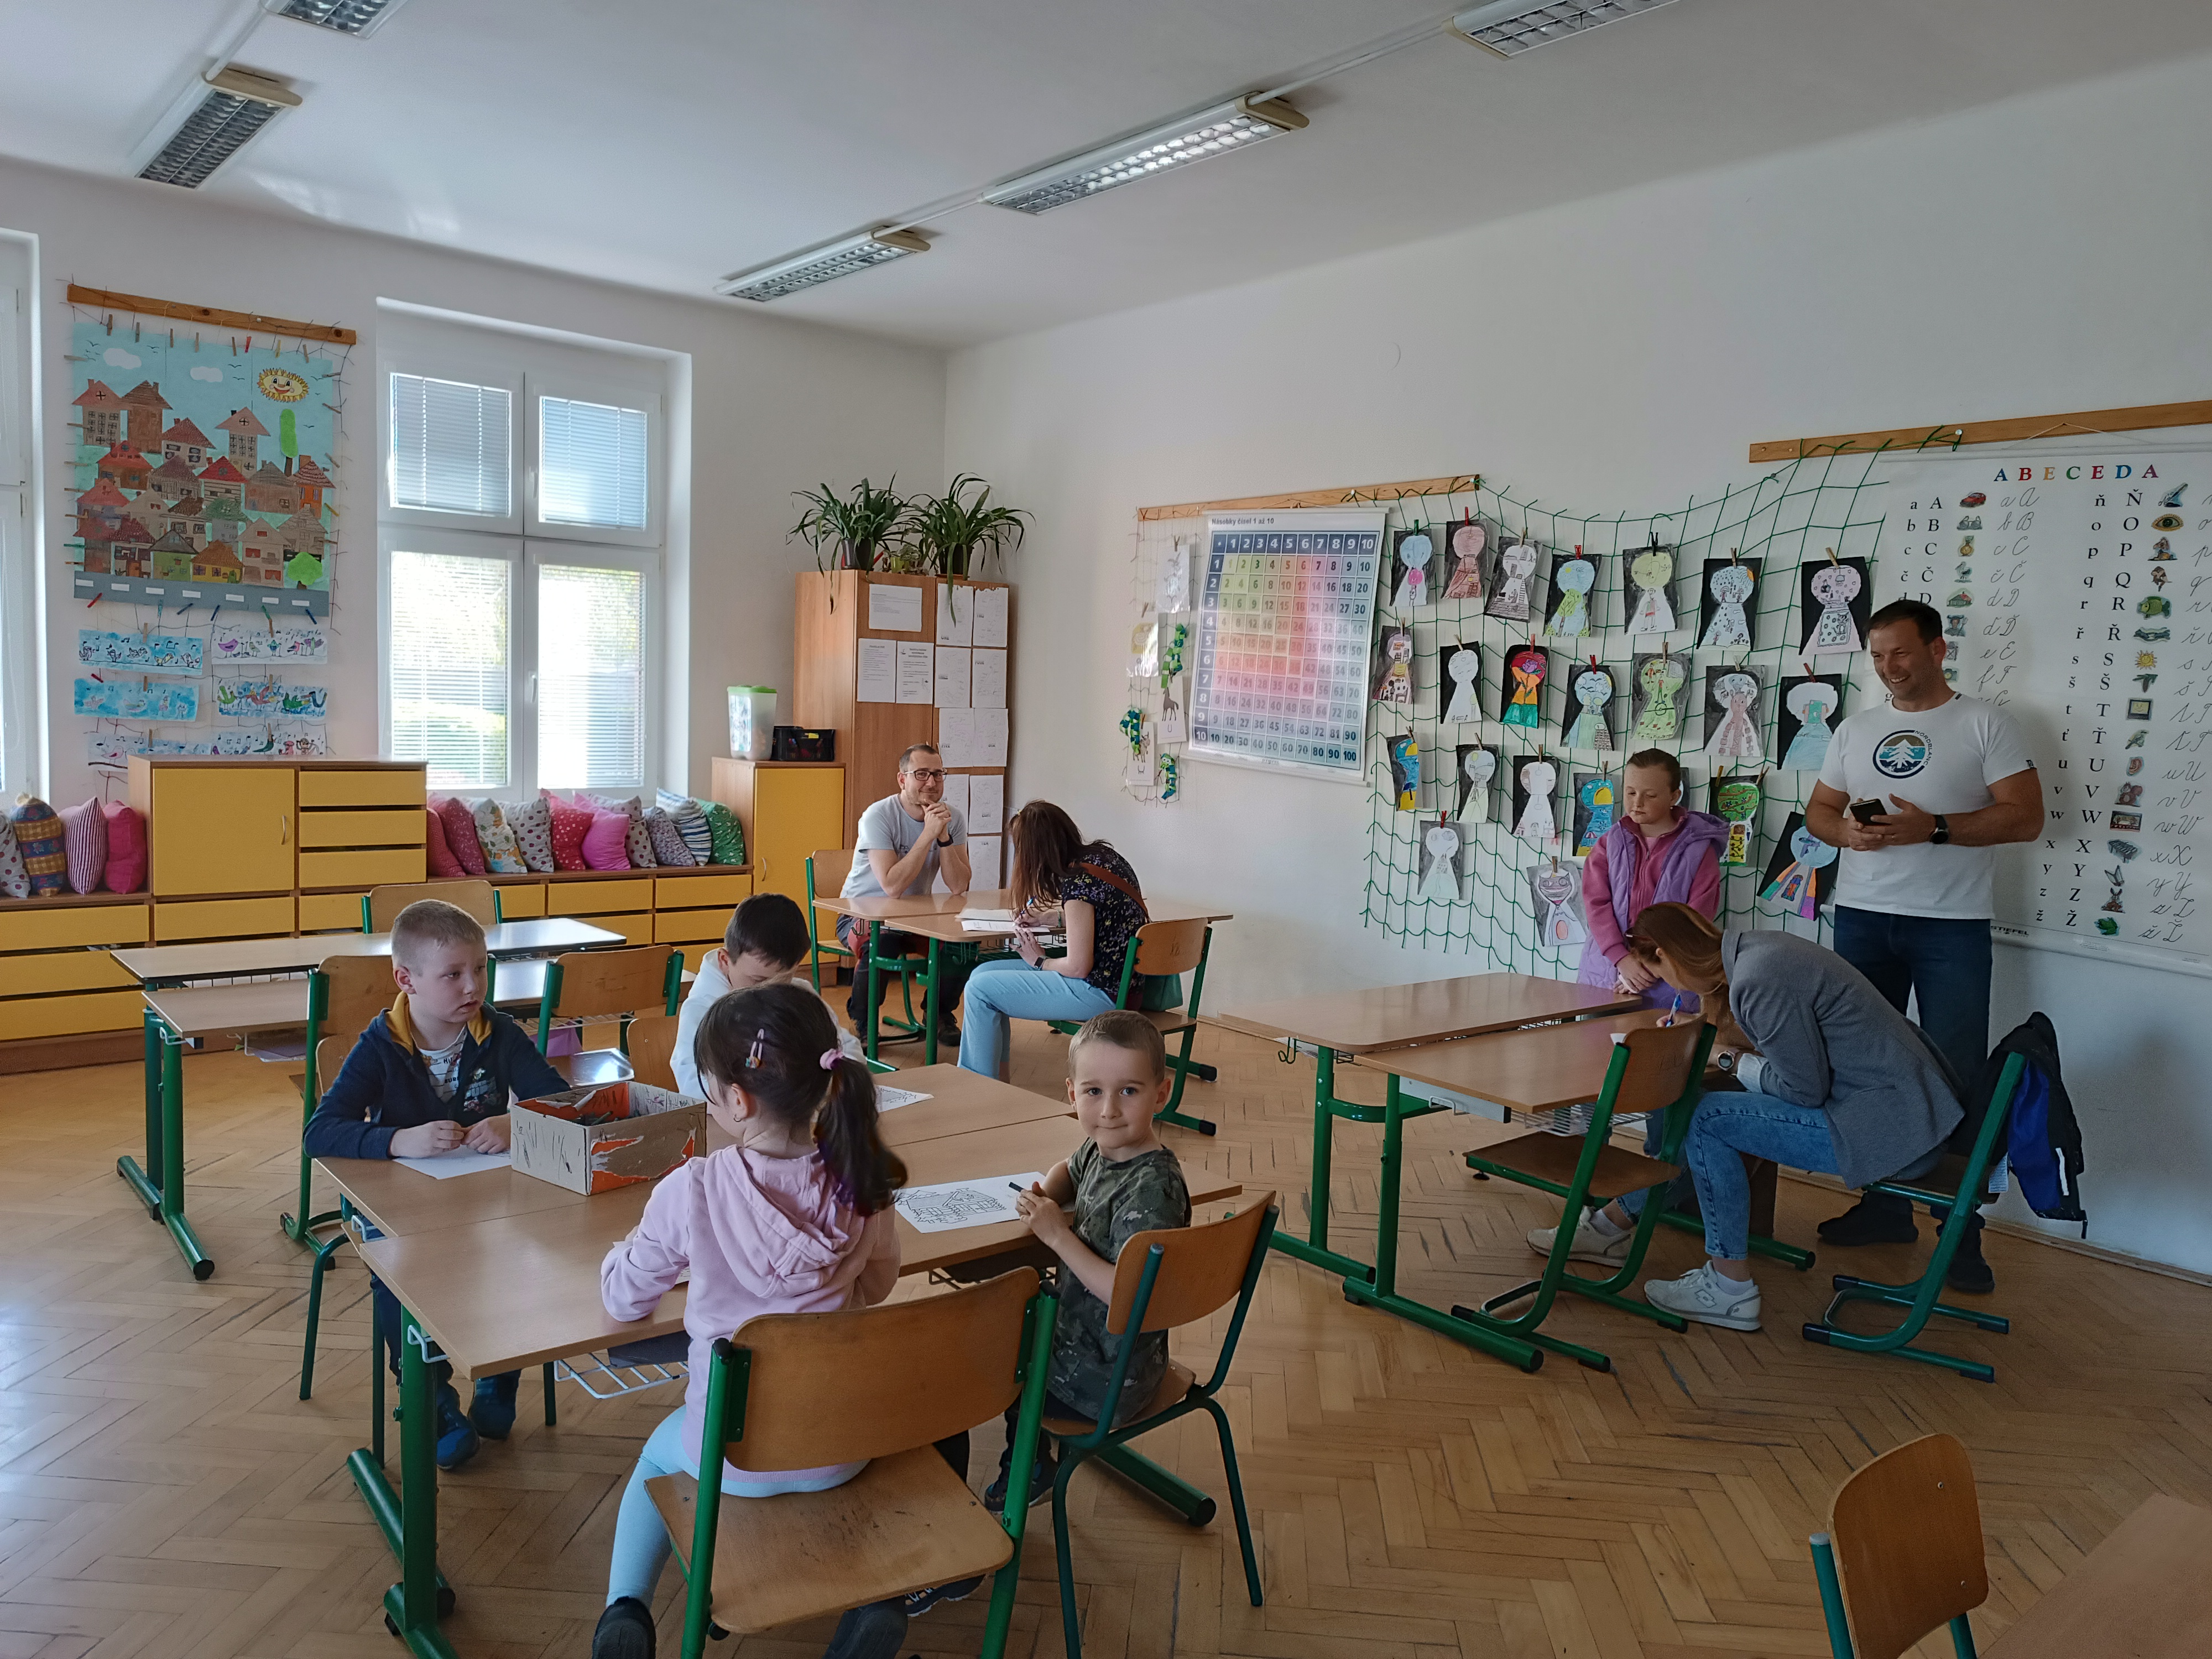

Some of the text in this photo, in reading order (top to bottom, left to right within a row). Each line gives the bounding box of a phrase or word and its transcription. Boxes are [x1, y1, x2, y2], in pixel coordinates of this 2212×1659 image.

[1930, 497, 1942, 509] A
[2095, 489, 2143, 506] ň Ň
[1907, 519, 1939, 531] b B
[2124, 517, 2138, 530] O
[1230, 539, 1373, 549] 1 2 3 4 5 6 7 8 9 10
[1925, 543, 1937, 555] C
[2088, 543, 2132, 559] p P
[1214, 559, 1219, 568] 1
[1255, 560, 1260, 568] 3
[1270, 560, 1275, 569] 4
[1286, 560, 1290, 570] 5
[1301, 561, 1306, 570] 6
[1316, 561, 1321, 570] 7
[1331, 561, 1336, 571] 8
[1347, 561, 1352, 571] 9
[1360, 562, 1370, 571] 10
[1901, 567, 1933, 582] č Č
[2084, 572, 2130, 588] q Q
[1210, 578, 1217, 588] 2
[1327, 582, 1336, 591] 16
[1342, 583, 1352, 592] 18
[1357, 583, 1368, 593] 20
[1208, 597, 1213, 607] 3
[1340, 603, 1349, 613] 27
[1354, 604, 1365, 614] 30
[2112, 597, 2125, 610] R
[1207, 617, 1213, 626] 4
[2077, 624, 2121, 640] ř Ř
[1206, 635, 1212, 645] 5
[1204, 655, 1211, 664] 6
[2104, 653, 2113, 666] S
[1203, 675, 1209, 684] 7
[2069, 674, 2110, 690] š Š
[1199, 693, 1207, 702] 8
[2067, 703, 2110, 717] t T
[1198, 712, 1356, 740] 9 9 18 27 36 45 54 63 72 81 90
[2063, 727, 2106, 744] ť Ť
[1197, 731, 1206, 740] 10
[1225, 735, 1234, 743] 20
[1239, 737, 1248, 746] 30
[1253, 739, 1263, 749] 40
[1267, 741, 1277, 750] 50
[1282, 743, 1293, 752] 60
[1298, 745, 1308, 754] 70
[1313, 747, 1324, 757] 80
[1328, 749, 1339, 759] 90
[1343, 751, 1356, 761] 100
[1914, 731, 1933, 765] NORDBLANC
[2059, 758, 2105, 771] u U
[2085, 785, 2099, 798] V
[2051, 810, 2102, 823] w W
[2046, 839, 2091, 853] x X
[2043, 864, 2086, 877] y Y
[2040, 888, 2080, 901] z Z
[2036, 910, 2077, 926] ž Ž
[1990, 926, 2030, 936] STIEFEL
